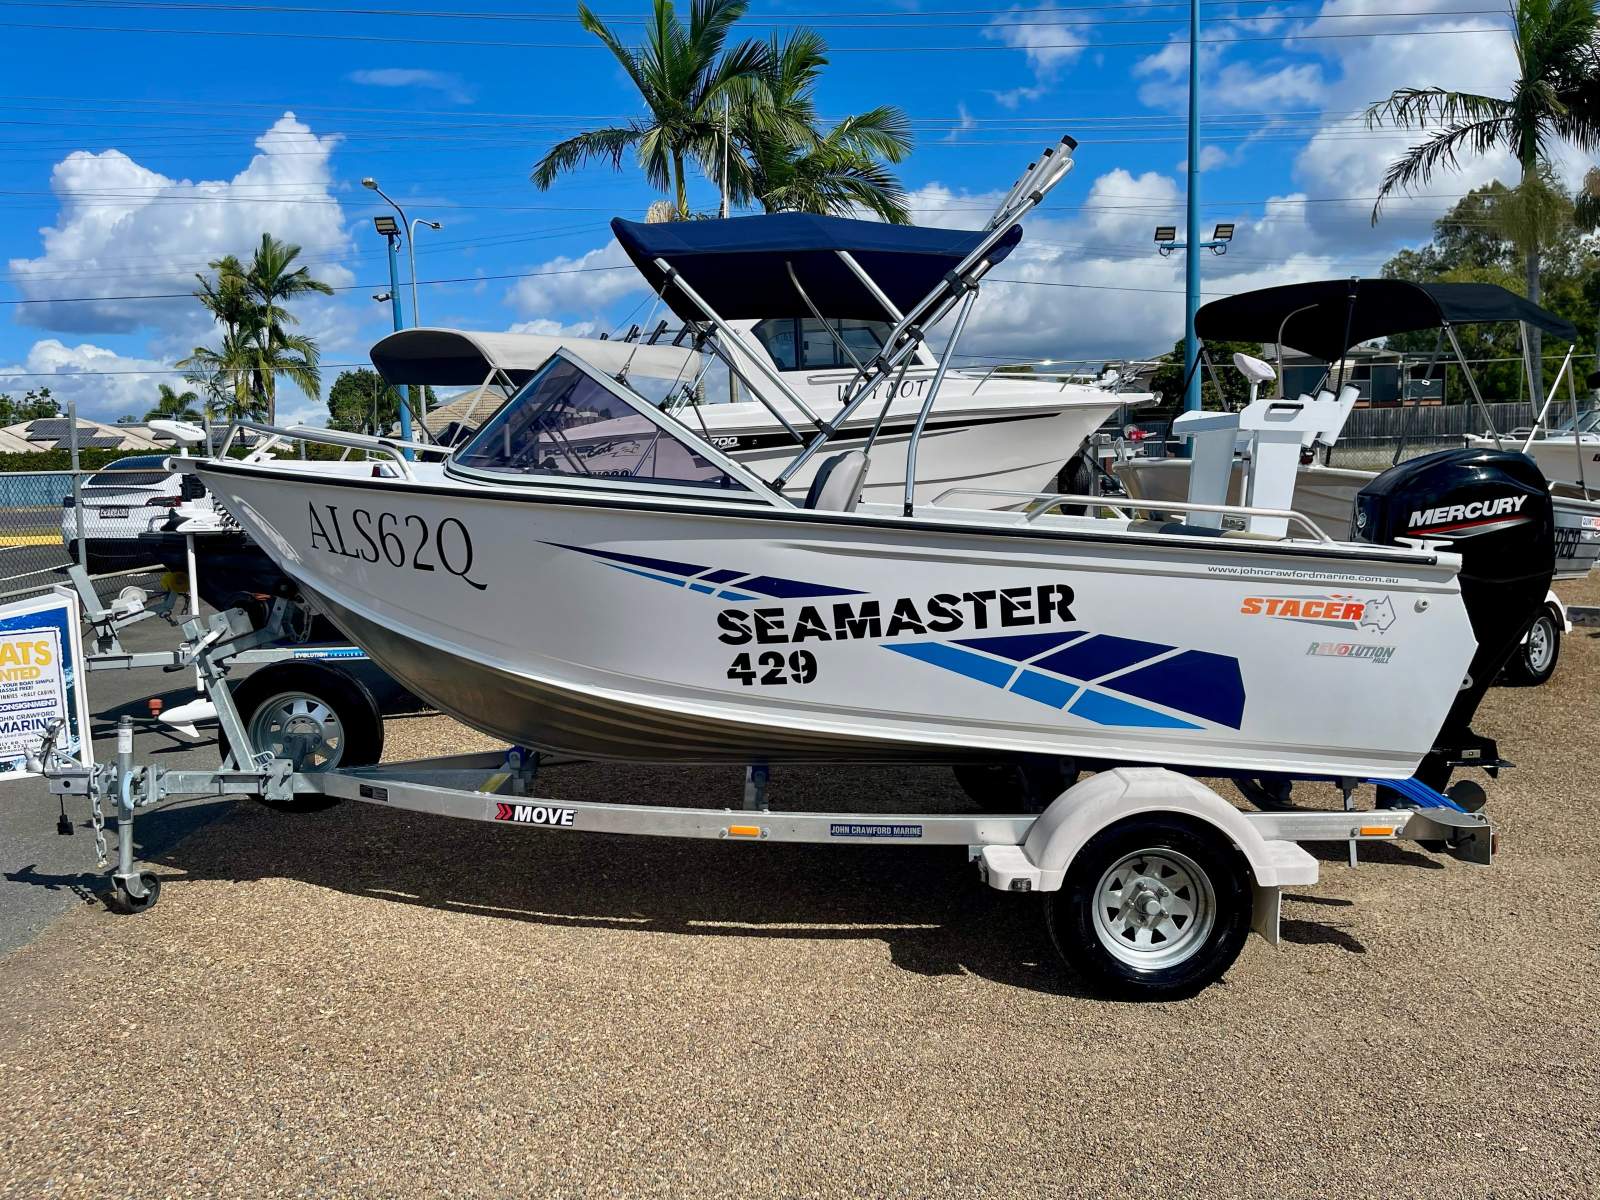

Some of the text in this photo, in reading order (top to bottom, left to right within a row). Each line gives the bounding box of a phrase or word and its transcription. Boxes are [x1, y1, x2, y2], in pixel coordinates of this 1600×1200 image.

[1408, 495, 1528, 527] MERCURY
[312, 501, 487, 590] ALS62Q
[1208, 566, 1399, 584] www.johncrawfordmarine.com.au
[717, 584, 1076, 645] SEAMASTER
[1240, 597, 1366, 621] STACER
[1305, 642, 1396, 658] REVOLUTION
[727, 649, 818, 686] 429
[16, 711, 55, 720] CRAWFORD
[514, 805, 576, 826] MOVE
[832, 826, 921, 835] JOHN CRAWFORD MARINE
